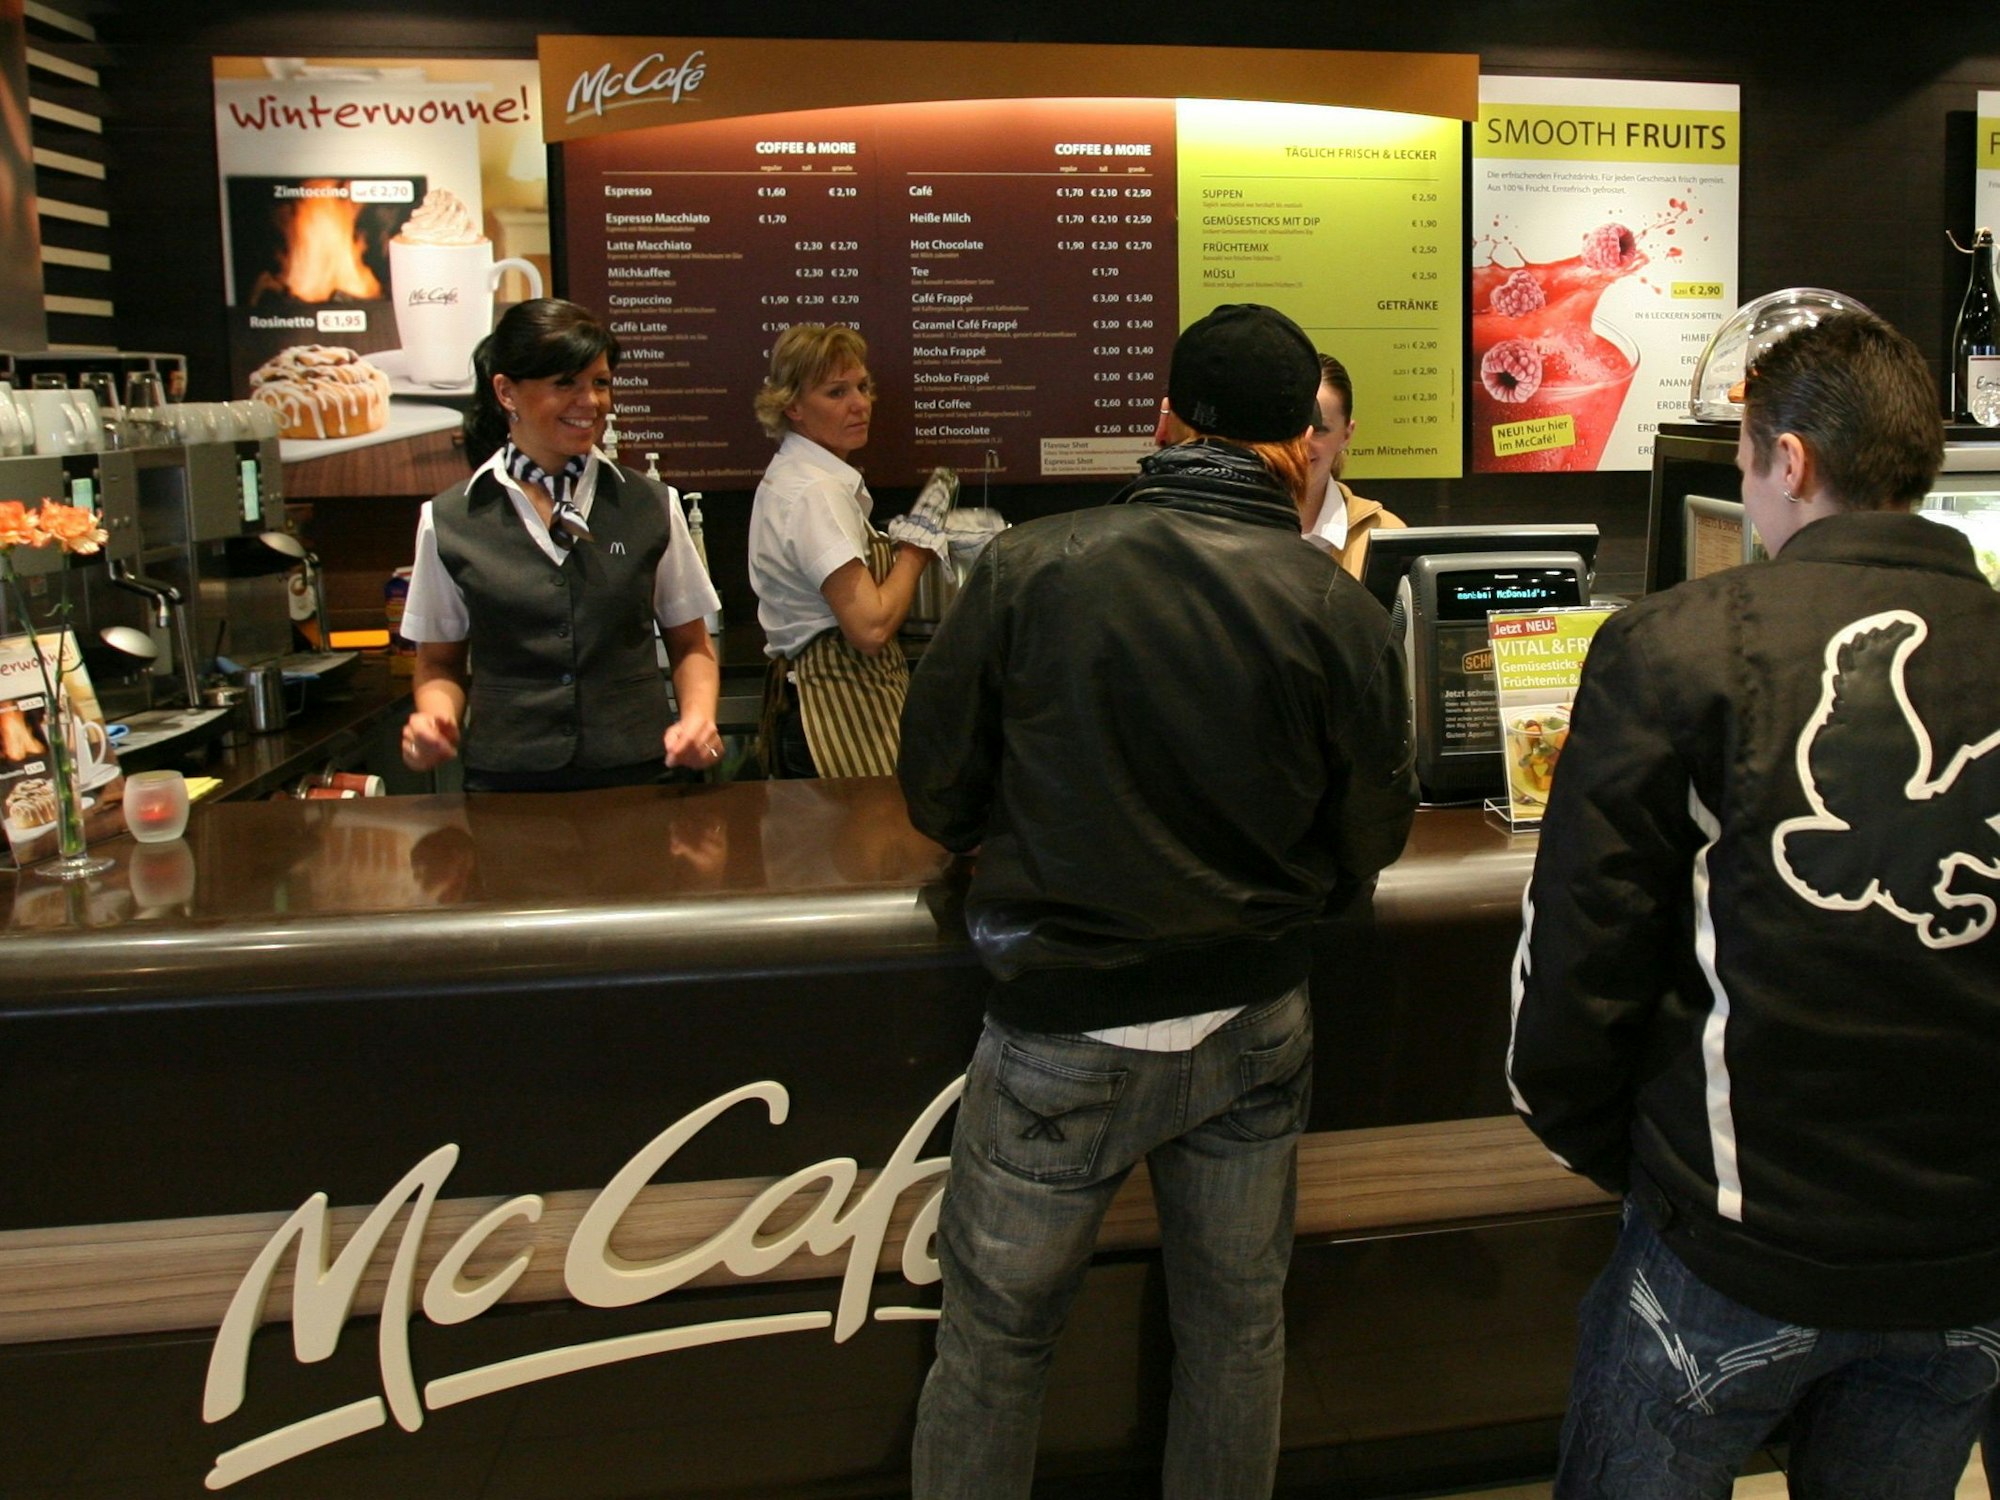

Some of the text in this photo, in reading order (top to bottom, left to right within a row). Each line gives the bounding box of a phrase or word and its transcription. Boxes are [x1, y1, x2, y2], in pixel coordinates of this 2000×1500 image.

[566, 50, 706, 116] McCafé
[229, 85, 531, 130] Winterwonne!
[1487, 118, 1726, 150] SMOOTH FRUITS
[755, 142, 857, 154] COFFEE & MORE
[1054, 143, 1152, 156] COFFEE & MORE
[1286, 147, 1437, 161] TÄGLICH FRISCH & LECKER
[274, 185, 349, 198] Zimtoccino
[604, 185, 652, 199] Espresso
[908, 185, 933, 197] Café
[1202, 189, 1243, 199] SUPPEN
[605, 212, 711, 226] Espresso Macchiato
[910, 213, 971, 224] Heiße Milch
[1202, 215, 1321, 226] GEMÜSESTICKS MIT DIP
[607, 240, 692, 251] Latte Macchiato
[910, 239, 984, 250] Hot Chocolate
[1203, 242, 1269, 252] FRÜCHTEMIX
[608, 267, 671, 278] Milchkaffee
[911, 267, 930, 277] Tee
[1203, 268, 1236, 279] MÜSLI
[1697, 285, 1720, 296] 2,90
[609, 294, 672, 307] Cappuccino
[911, 293, 973, 306] Café Frappé
[1377, 299, 1438, 311] GETRÄNKE
[1651, 312, 1690, 320] LECKEREN
[250, 316, 315, 329] Rosinetto
[334, 316, 361, 329] 1,95
[610, 321, 668, 332] Caffè Latte
[912, 319, 1018, 332] Caramel Café Frappé
[633, 349, 665, 359] White
[913, 346, 986, 358] Mocha Frappé
[612, 376, 649, 386] Mocha
[914, 372, 990, 385] Schoko Frappé
[613, 403, 651, 414] Vienna
[915, 399, 971, 409] Iced Coffee
[915, 425, 990, 436] Iced Chocolate
[1497, 421, 1568, 439] NEU! Nur hier
[1499, 434, 1556, 451] im McCafé!
[1351, 446, 1438, 456] zum Mitnehmen
[1494, 619, 1555, 636] Jetzt NEU:
[1497, 639, 1550, 657] VITAL
[1551, 638, 1565, 654] &
[1501, 659, 1578, 673] Gemüsesticks
[1503, 674, 1567, 687] Früchtemix
